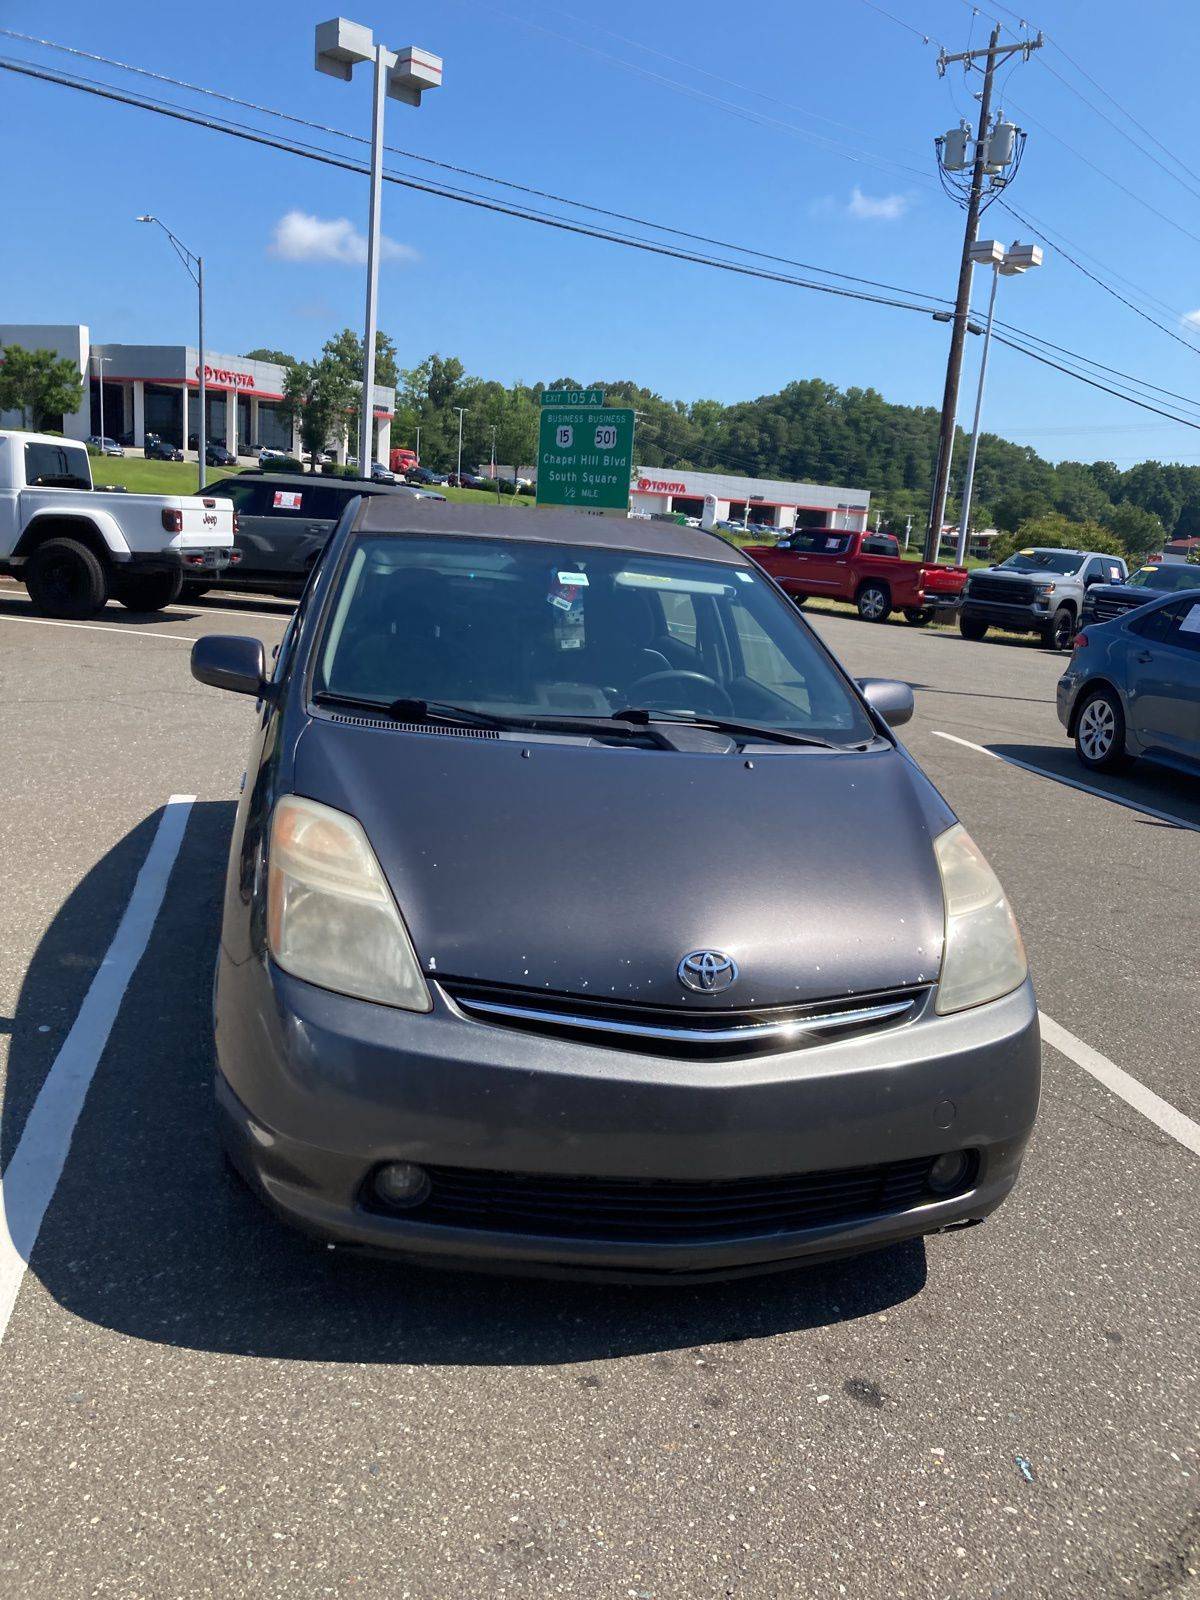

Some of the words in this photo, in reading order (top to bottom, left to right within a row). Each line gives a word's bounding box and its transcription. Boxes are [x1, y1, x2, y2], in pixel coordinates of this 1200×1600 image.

[213, 368, 255, 388] TOYOTA
[545, 395, 561, 403] EXIT
[567, 392, 584, 404] 105
[589, 393, 597, 404] A
[547, 414, 584, 423] BUSINESS
[588, 415, 626, 423] BUSINESS
[560, 429, 570, 444] 15
[595, 430, 616, 444] 501
[543, 453, 576, 465] Chapel
[580, 455, 599, 466] Hill
[603, 456, 626, 466] Blvd
[549, 470, 577, 481] South
[582, 472, 618, 484] Square
[581, 489, 599, 498] MILE
[651, 481, 686, 493] TOYOTA
[203, 512, 218, 527] Jeep
